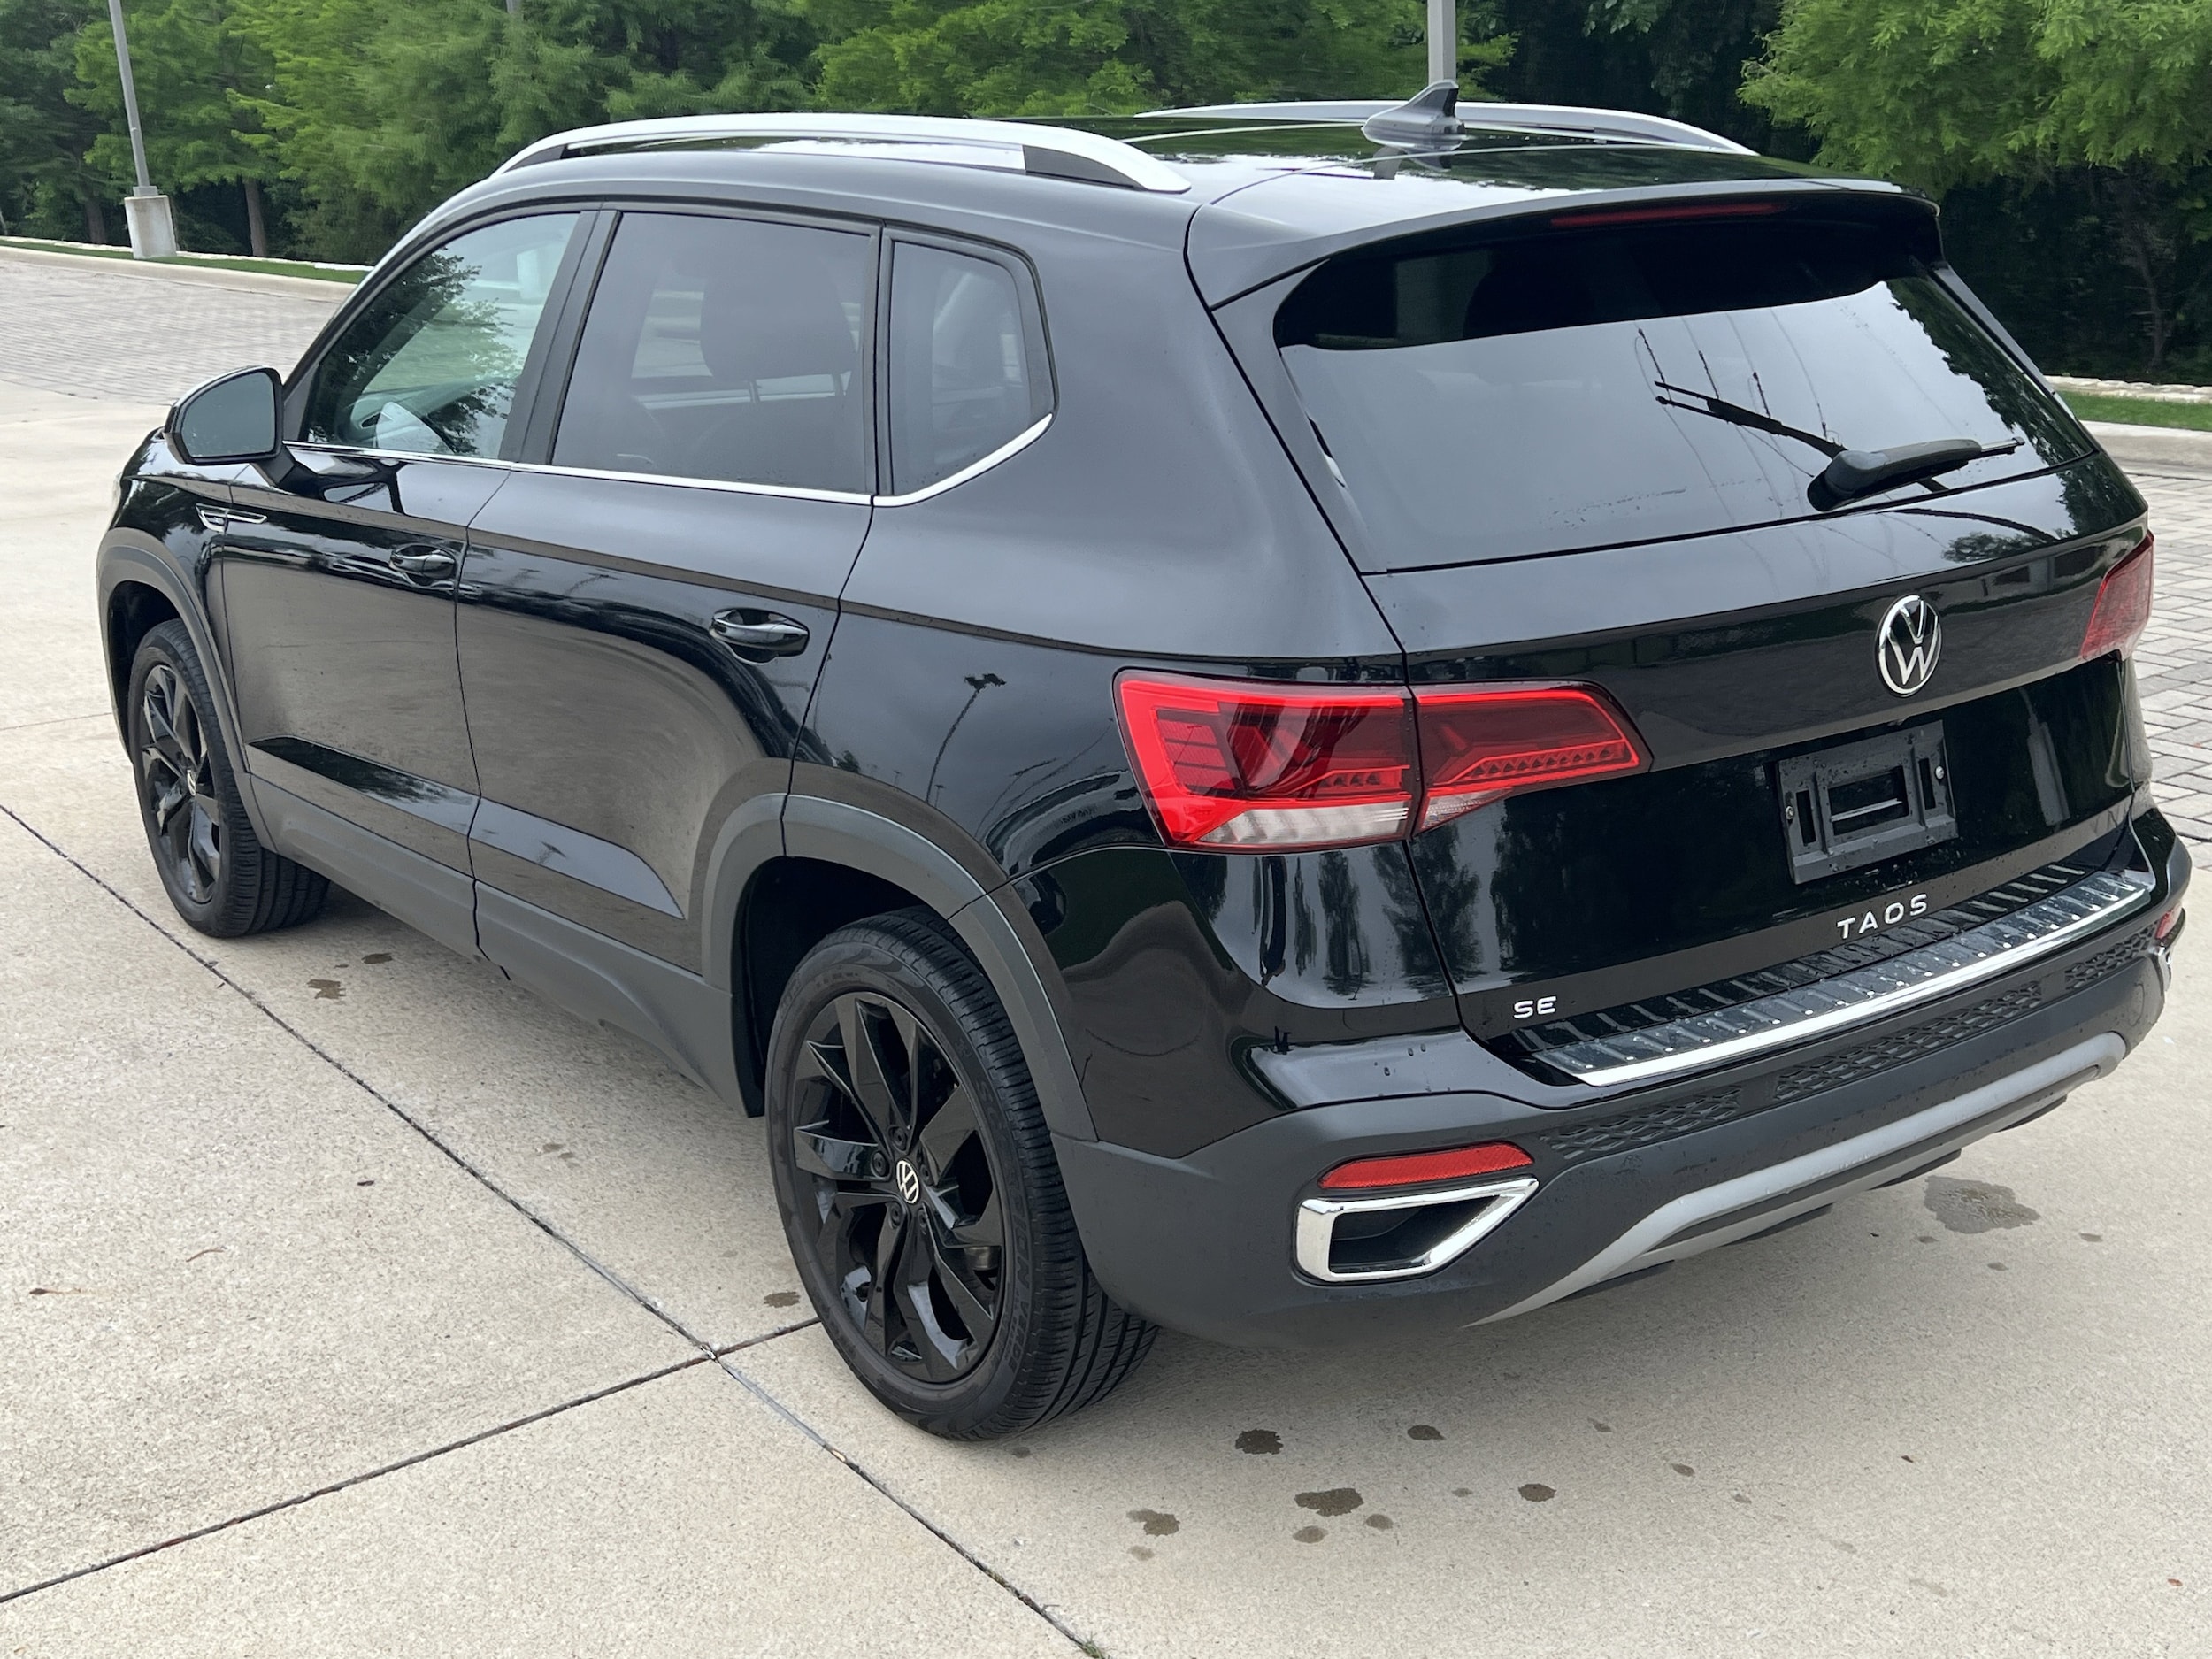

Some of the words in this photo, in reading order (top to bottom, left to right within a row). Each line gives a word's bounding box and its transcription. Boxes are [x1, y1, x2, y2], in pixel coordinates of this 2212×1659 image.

[1883, 598, 1939, 687] VW
[1836, 894, 1928, 939] TAOS
[1514, 996, 1557, 1019] SE
[896, 1160, 919, 1202] VW
